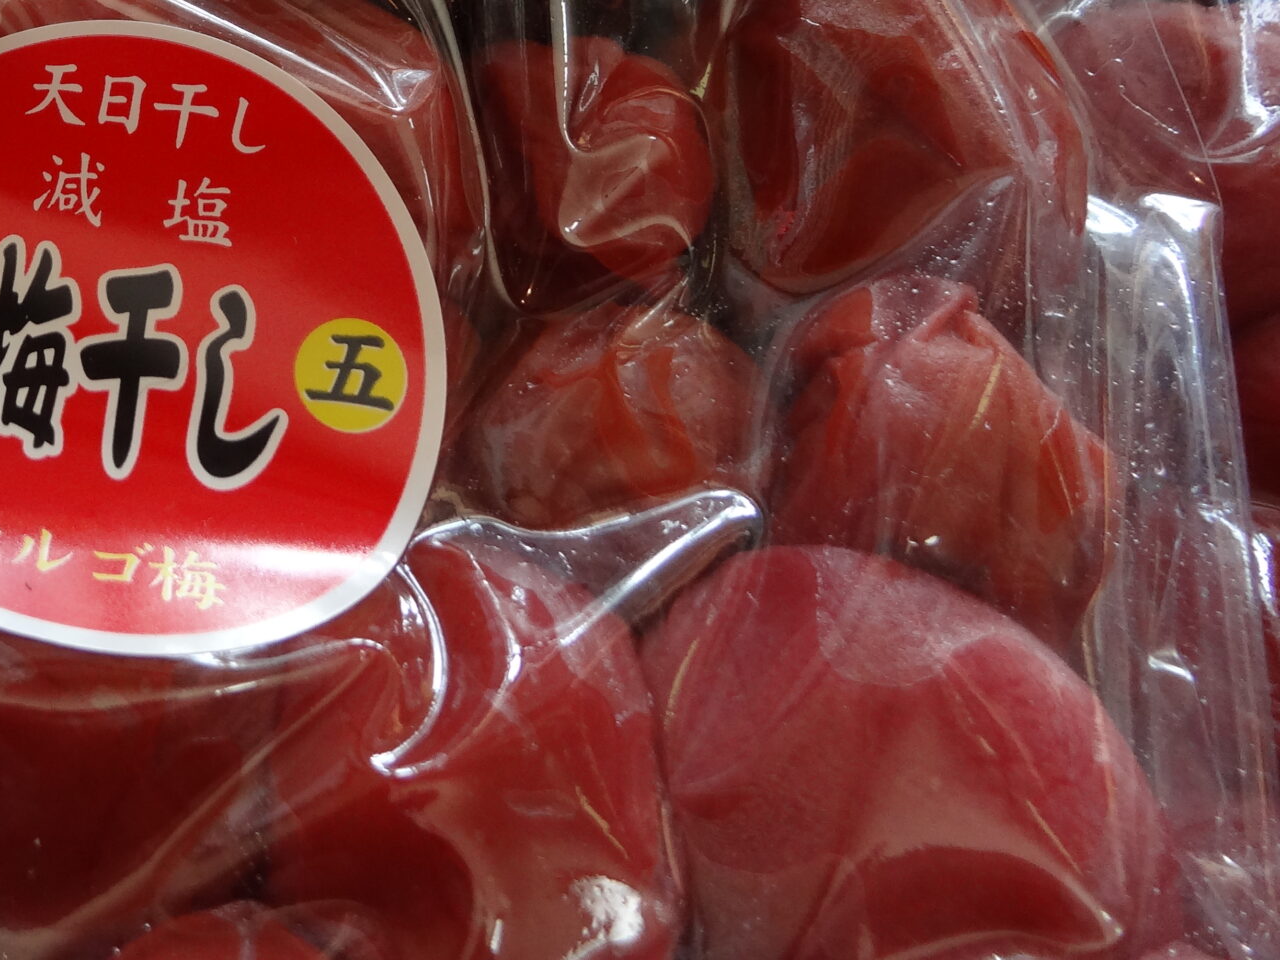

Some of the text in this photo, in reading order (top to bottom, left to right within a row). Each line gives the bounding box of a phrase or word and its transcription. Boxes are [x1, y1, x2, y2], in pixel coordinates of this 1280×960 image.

[25, 63, 266, 154] 天日干し
[303, 333, 396, 415] 五
